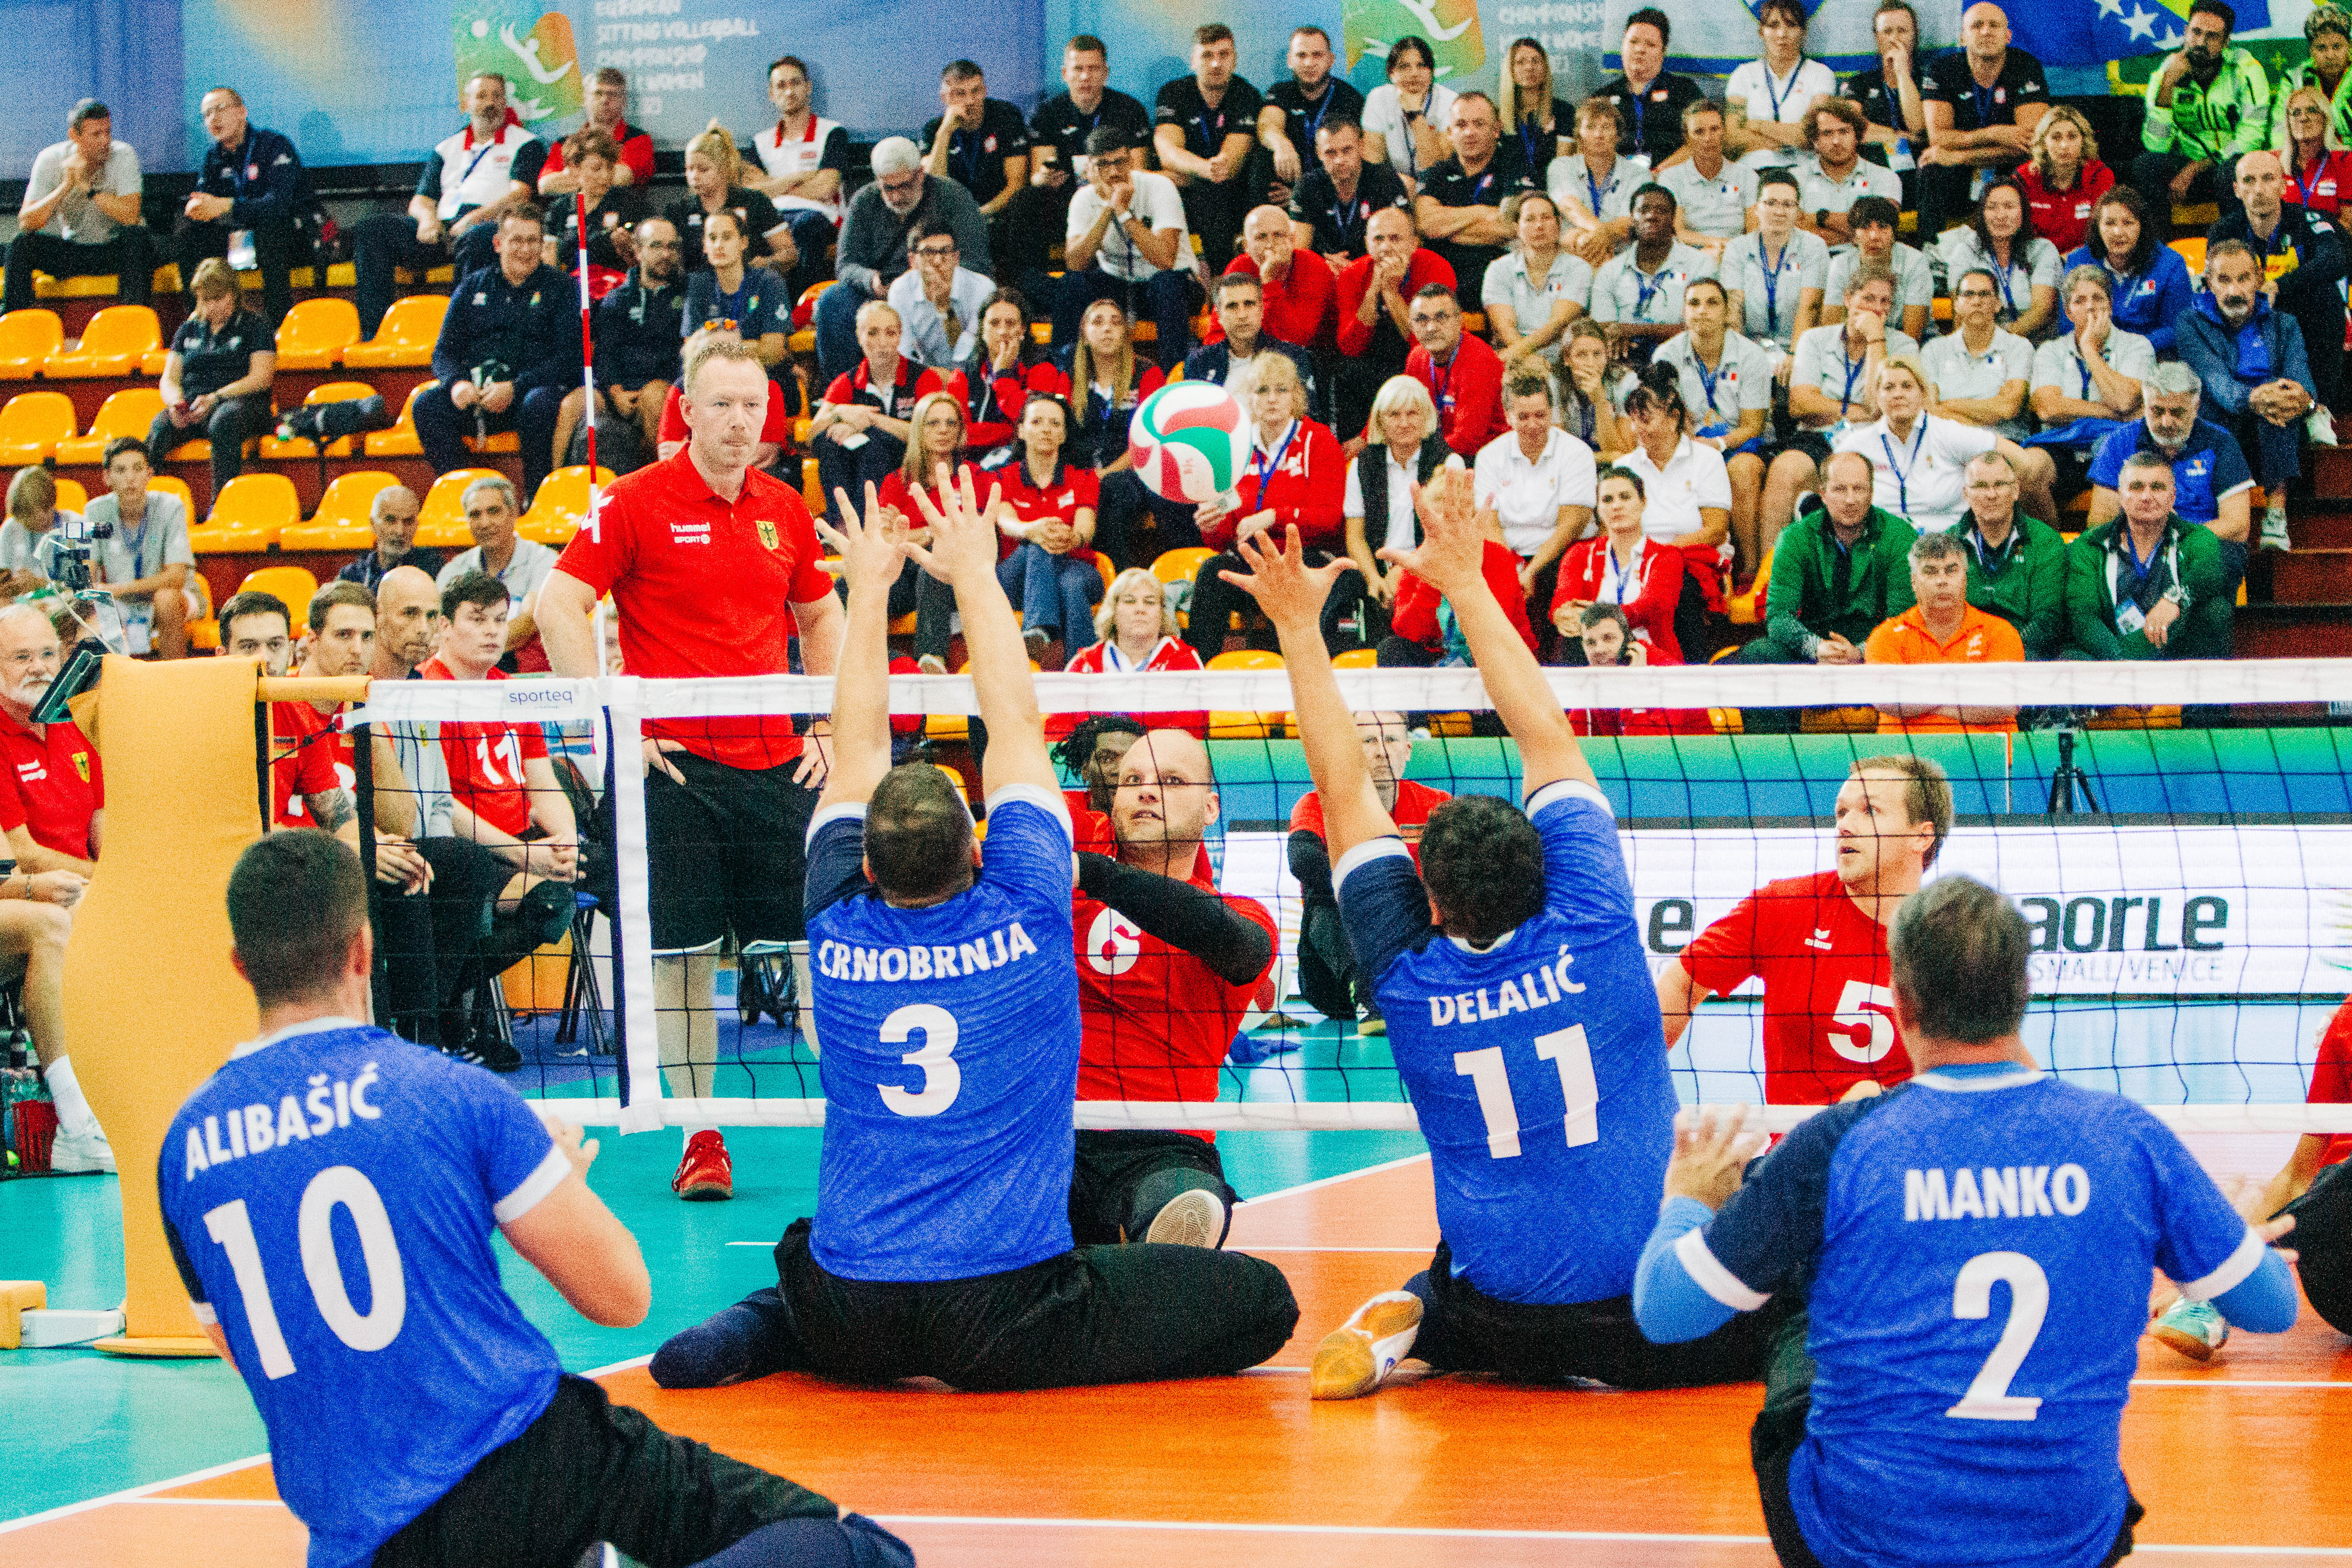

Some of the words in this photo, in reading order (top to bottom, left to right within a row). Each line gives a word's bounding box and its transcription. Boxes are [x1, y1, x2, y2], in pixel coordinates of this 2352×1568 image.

[670, 521, 711, 532] hummel
[509, 690, 573, 705] sporteq
[476, 728, 526, 785] 11
[818, 922, 1038, 982] CRNOBRNJA
[1087, 907, 1141, 975] 6
[2020, 896, 2228, 953] aorle
[1428, 944, 1586, 1026] DELALIĆ
[2129, 956, 2224, 983] VENICE
[1828, 980, 1896, 1063] 5
[877, 1003, 961, 1117] 3
[1454, 1023, 1599, 1158] 11
[186, 1061, 382, 1181] ALIBAŠIĆ
[1905, 1163, 2091, 1221] MANKO
[203, 1166, 406, 1380] 10
[1945, 1251, 2049, 1420] 2
